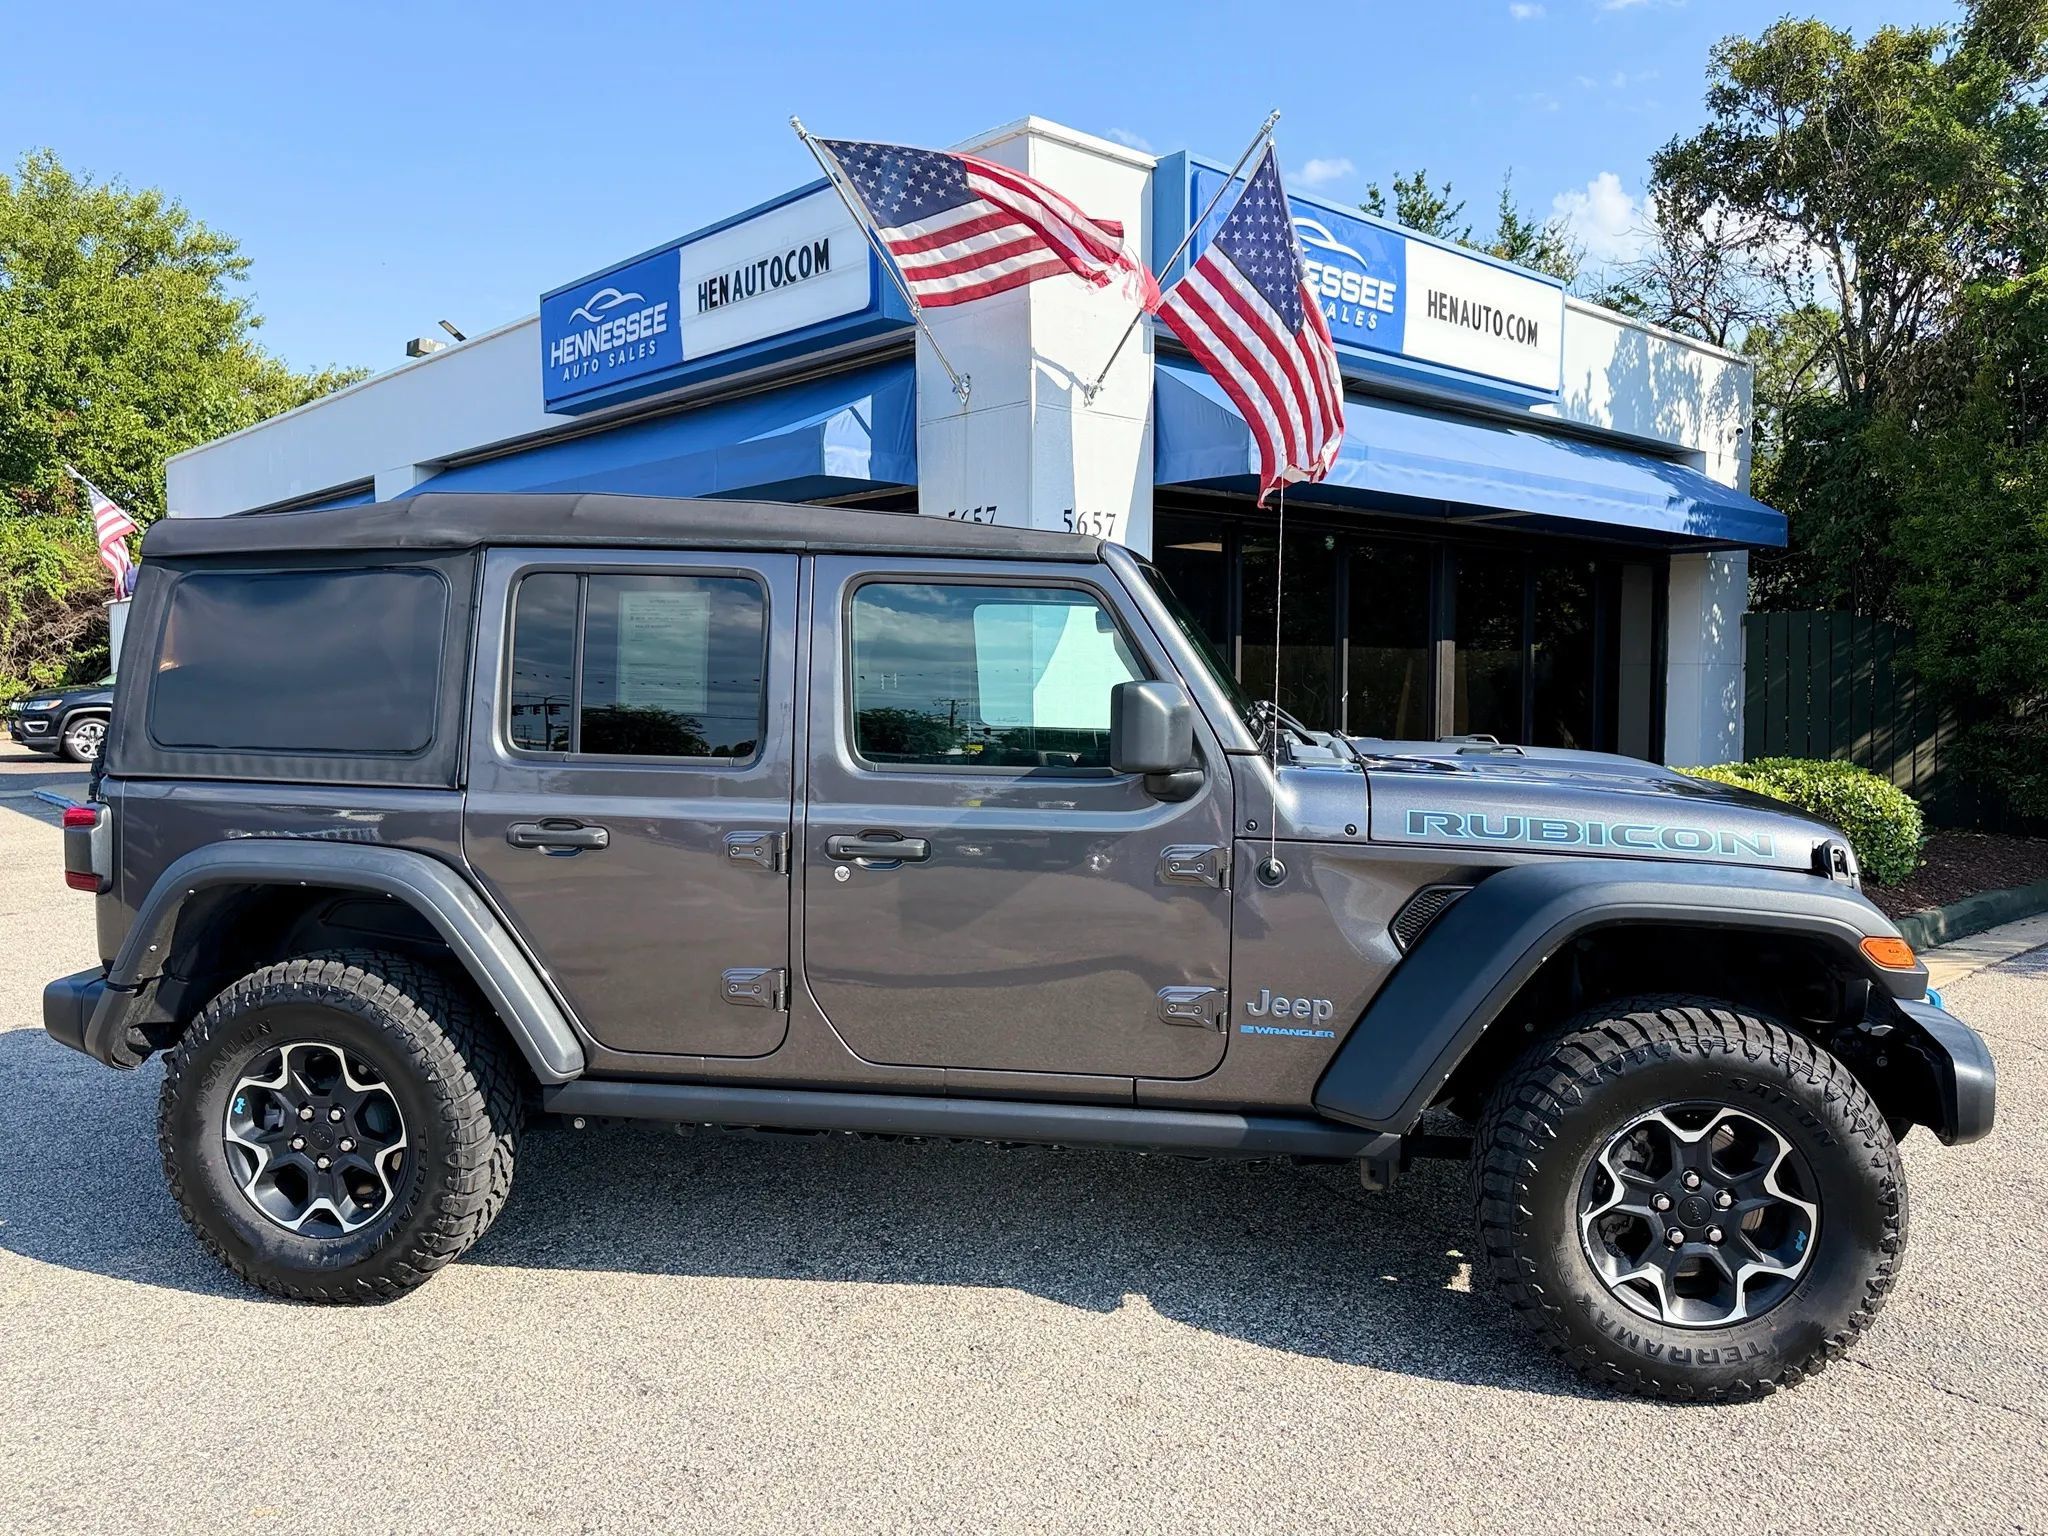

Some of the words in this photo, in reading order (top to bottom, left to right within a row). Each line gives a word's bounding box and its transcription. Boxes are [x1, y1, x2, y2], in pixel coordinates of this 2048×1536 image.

[698, 237, 830, 313] HENAUTO.COM
[1304, 258, 1397, 314] ESSEE
[550, 301, 668, 369] HENNESSEE
[1325, 300, 1378, 331] ALES
[563, 358, 600, 381] AUTO
[608, 340, 657, 368] SALES
[1063, 508, 1116, 537] 5657
[1407, 810, 1775, 858] RUBICON
[1246, 989, 1334, 1025] Jeep
[1254, 1026, 1336, 1038] WRANGLER
[1576, 1293, 1768, 1366] TERRAMAX
